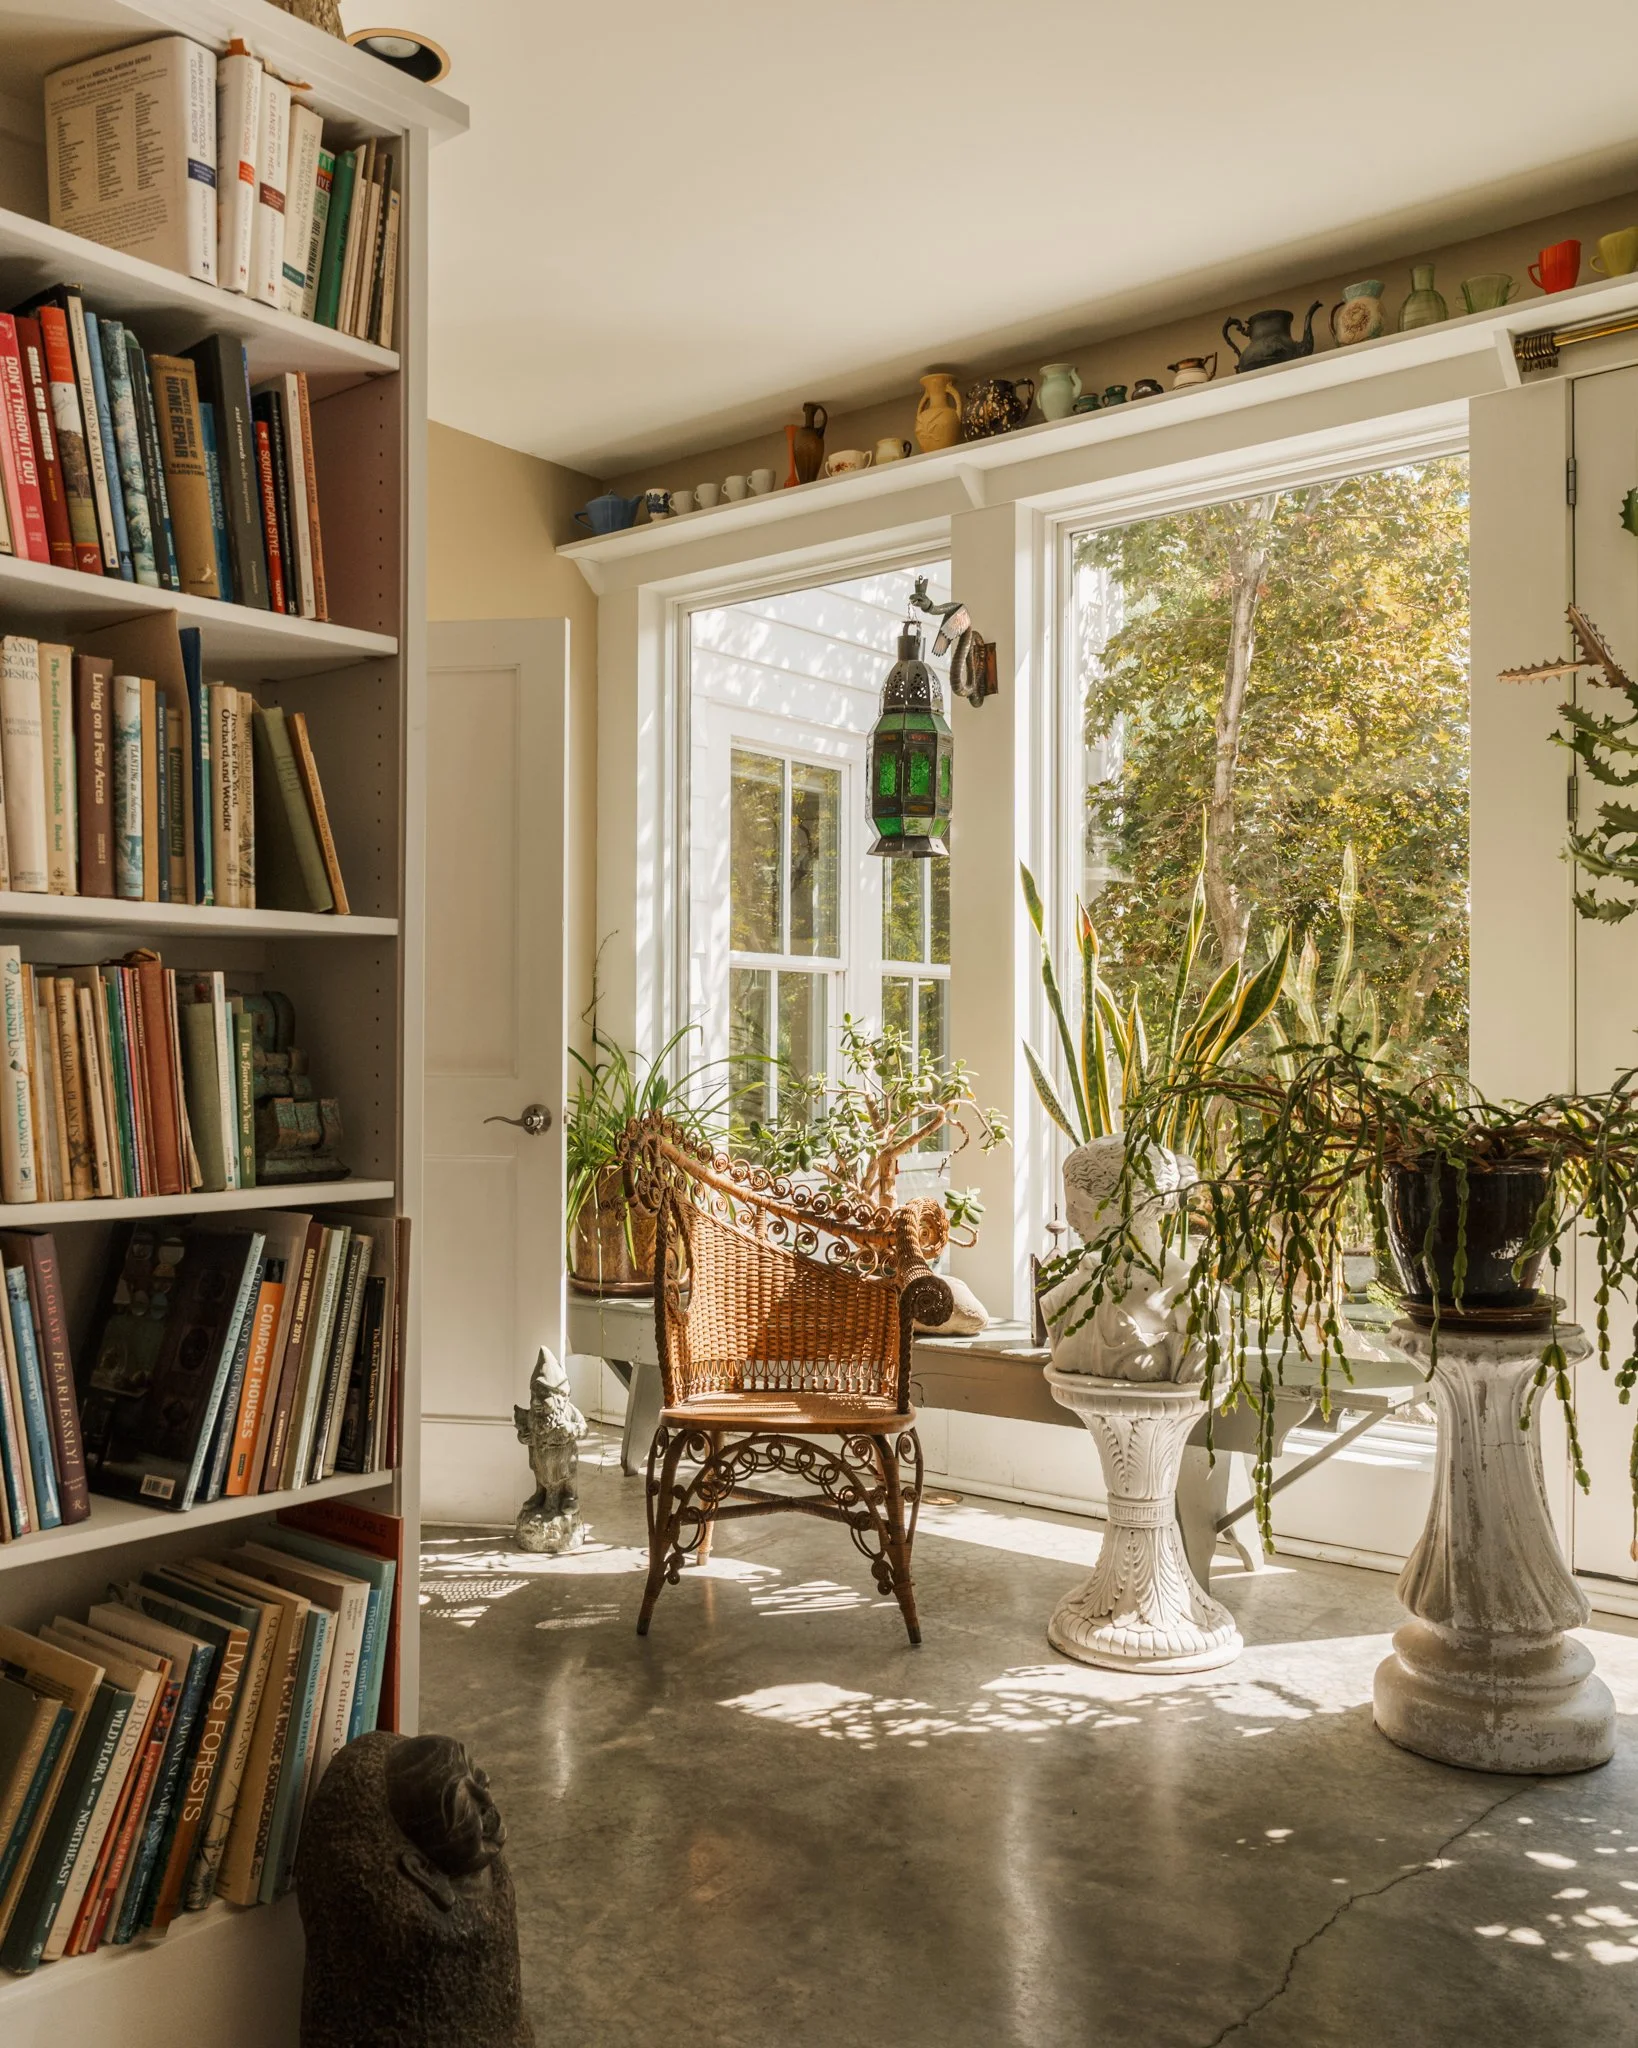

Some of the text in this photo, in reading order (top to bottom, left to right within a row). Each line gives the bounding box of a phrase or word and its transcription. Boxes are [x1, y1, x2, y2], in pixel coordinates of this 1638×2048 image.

[267, 92, 276, 180] CLEANSE TO HEAL
[310, 218, 322, 236] JOEL
[27, 345, 41, 384] SMALL
[81, 375, 92, 396] THE
[4, 354, 37, 488] DON'T THROW IT OUT
[32, 386, 46, 410] GAS
[84, 398, 97, 429] PARTS
[166, 376, 188, 458] HOME REPAIR
[36, 410, 54, 462] ENGINES
[89, 429, 98, 443] OF
[92, 452, 105, 486] HOUSE
[155, 470, 170, 519] CONTRACTOR
[260, 449, 280, 557] SOUTH AFRICAN STYLE
[50, 657, 63, 815] The Seed Handbook
[89, 672, 105, 804] Living on a Few Acres
[128, 743, 138, 781] PLANTING
[230, 712, 239, 808] Trees for the Yard,
[219, 708, 231, 832] Orchard, and Woodlot
[3, 976, 18, 1037] AROUND
[60, 1032, 75, 1084] GARDEN
[241, 1042, 250, 1058] The
[15, 1079, 30, 1159] DAVID OWEN
[65, 1089, 80, 1137] PLANTS
[302, 1247, 316, 1278] GARDEN
[344, 1253, 357, 1298] PENELOPE
[244, 1263, 263, 1316] CREATING
[294, 1279, 310, 1321] ORNAMENT
[321, 1272, 334, 1313] PRUNING
[235, 1346, 246, 1362] SO
[238, 1319, 252, 1343] NOT
[38, 1258, 80, 1466] DECORATE FEARLESSLY!
[231, 1362, 243, 1382] BIG
[240, 1302, 275, 1439] COMPACT HOUSES
[328, 1354, 340, 1391] GARDEN
[223, 1384, 239, 1422] HOUSE
[354, 1605, 377, 1706] modern comfort
[232, 1615, 278, 1771] CLASSIC GARDEN PLANTS
[296, 1616, 327, 1759] PERIOD FINISHES AND EFFECTS
[332, 1647, 355, 1744] The Painter's
[105, 1705, 127, 1743] WILD
[117, 1696, 150, 1759] BIRDS
[165, 1712, 194, 1779] JAPANESE
[181, 1638, 247, 1826] LIVING FORESTS
[90, 1740, 115, 1785] FLORA
[113, 1761, 126, 1780] OF
[252, 1649, 299, 1860] THE FOLK MUSIC SOURCEBOOK
[128, 1749, 156, 1823] LANDSCAPING
[54, 1807, 91, 1888] NORTHEAST
